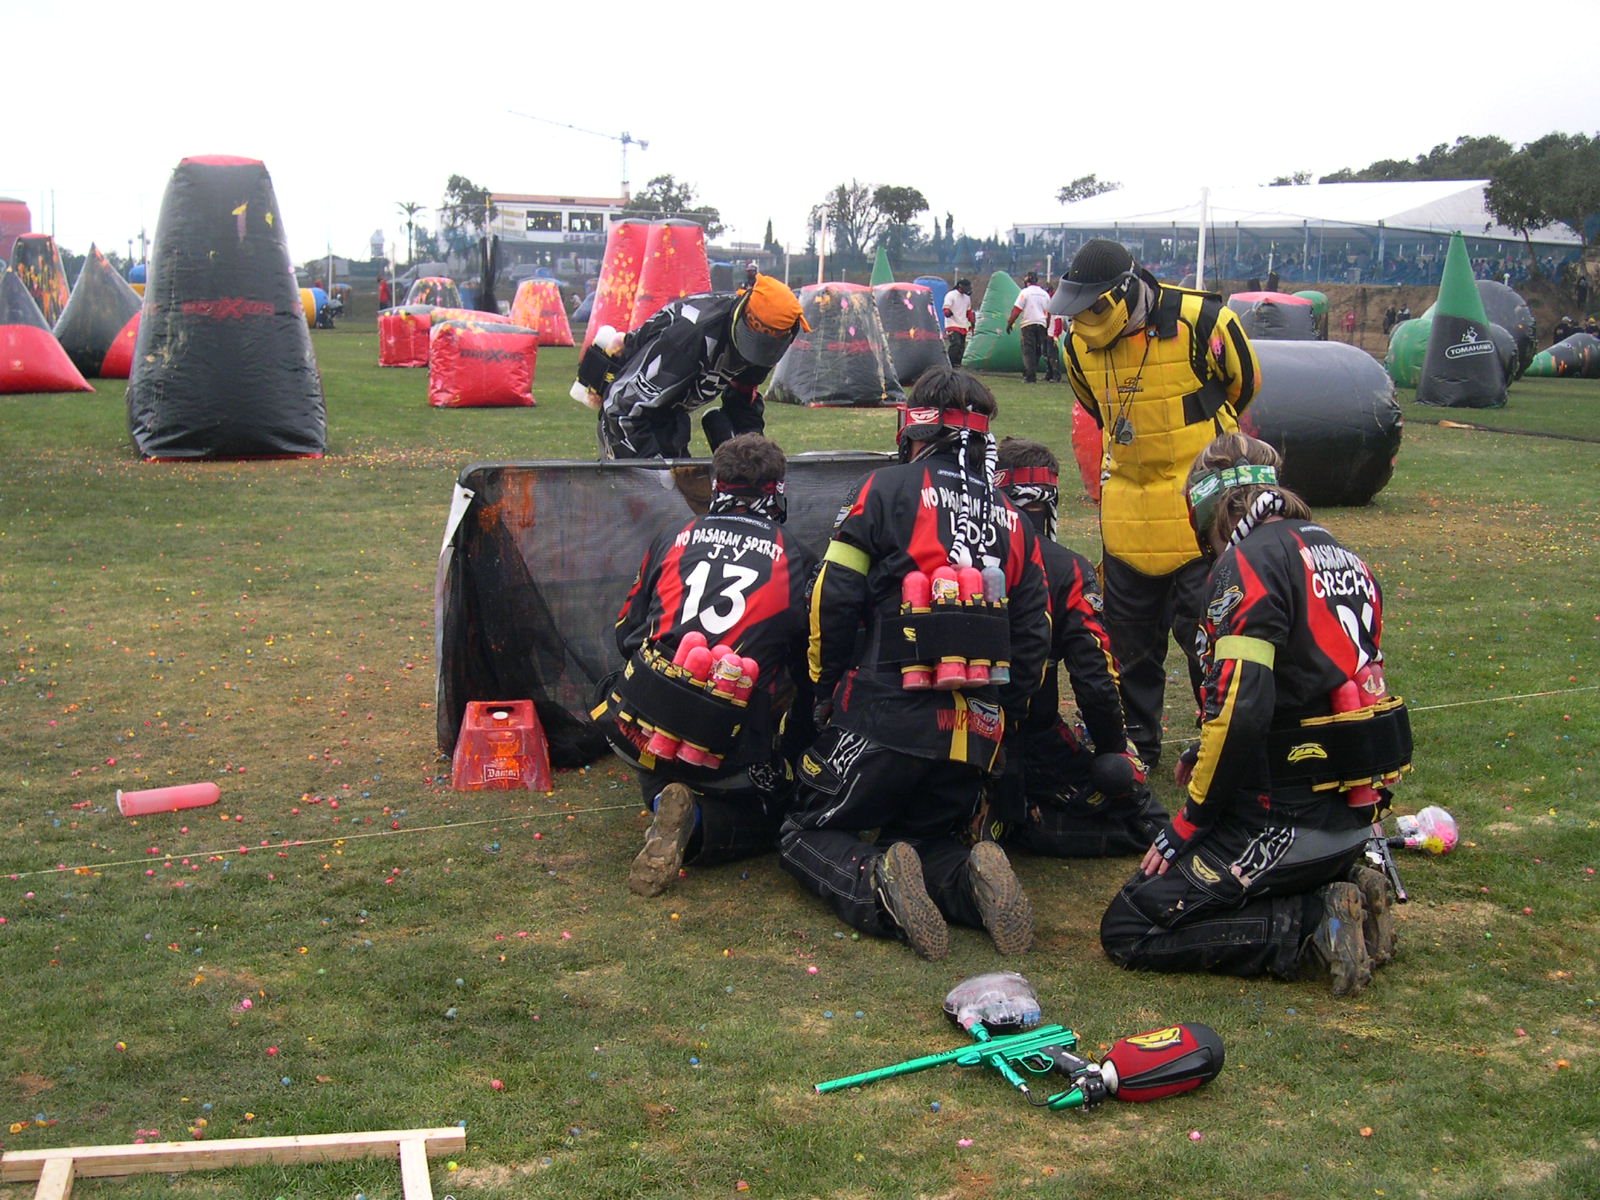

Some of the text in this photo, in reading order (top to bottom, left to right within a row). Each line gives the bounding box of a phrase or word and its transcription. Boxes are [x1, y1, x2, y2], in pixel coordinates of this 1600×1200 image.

[1450, 344, 1492, 355] TOMAHAWK
[921, 487, 939, 509] NO
[675, 528, 784, 562] NO PASARAN SPIRIT
[949, 511, 997, 547] LDO
[680, 560, 759, 635] 13
